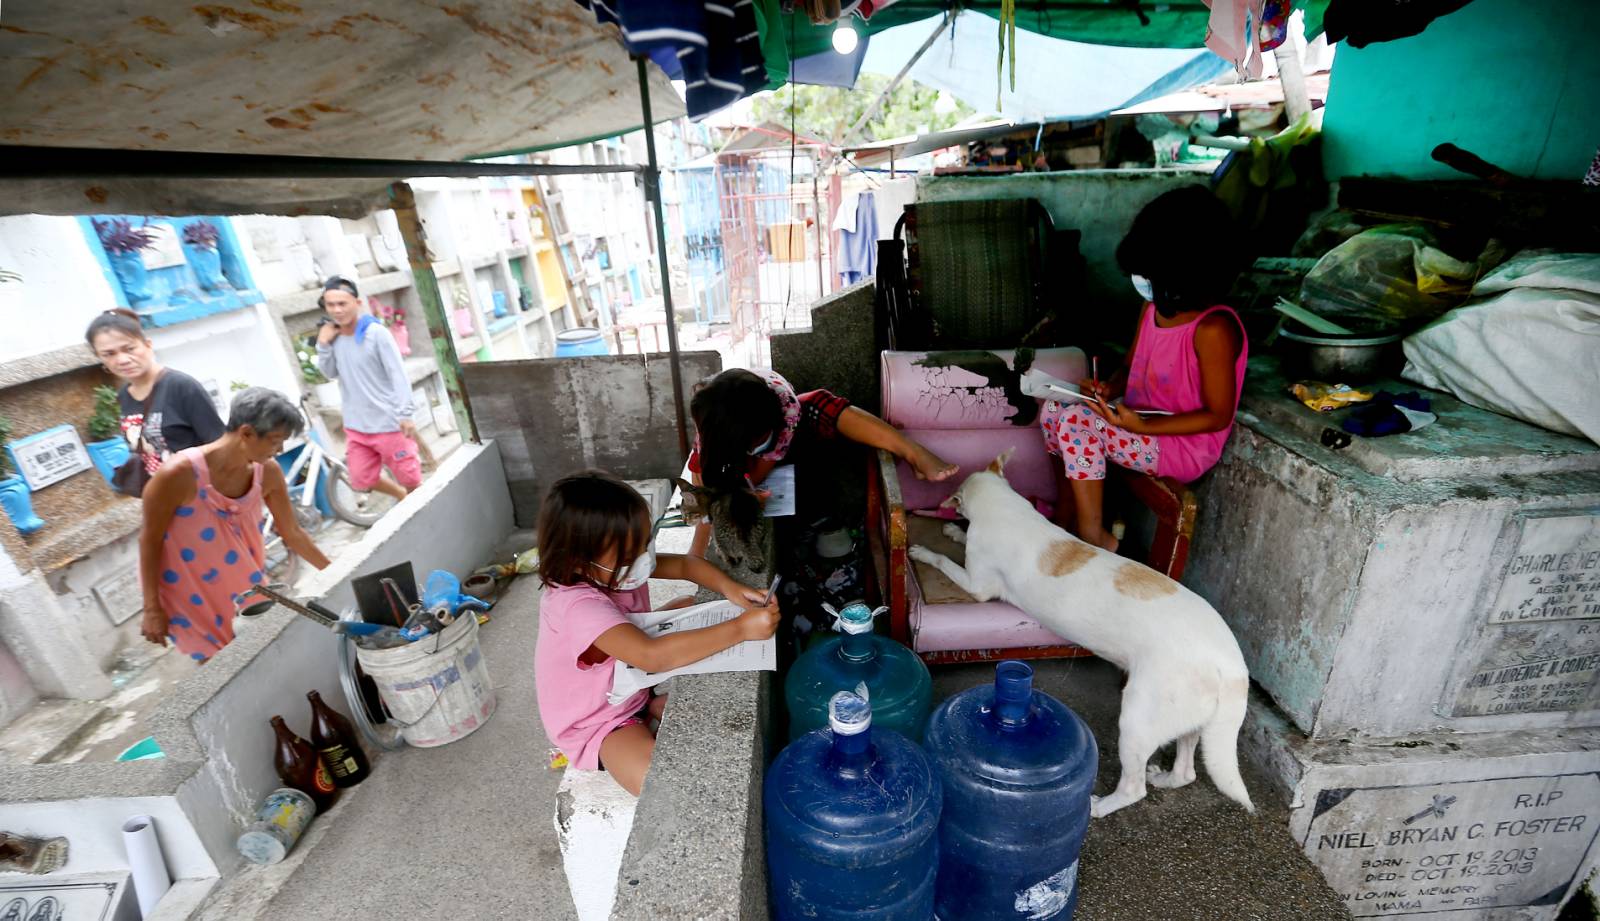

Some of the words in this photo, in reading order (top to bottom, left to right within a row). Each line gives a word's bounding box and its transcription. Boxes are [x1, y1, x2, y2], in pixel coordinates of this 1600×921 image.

[1514, 790, 1563, 809] R.I.P
[1318, 832, 1375, 850] NIEL
[1384, 825, 1458, 846] BRYAN
[1494, 815, 1587, 837] FOSTER
